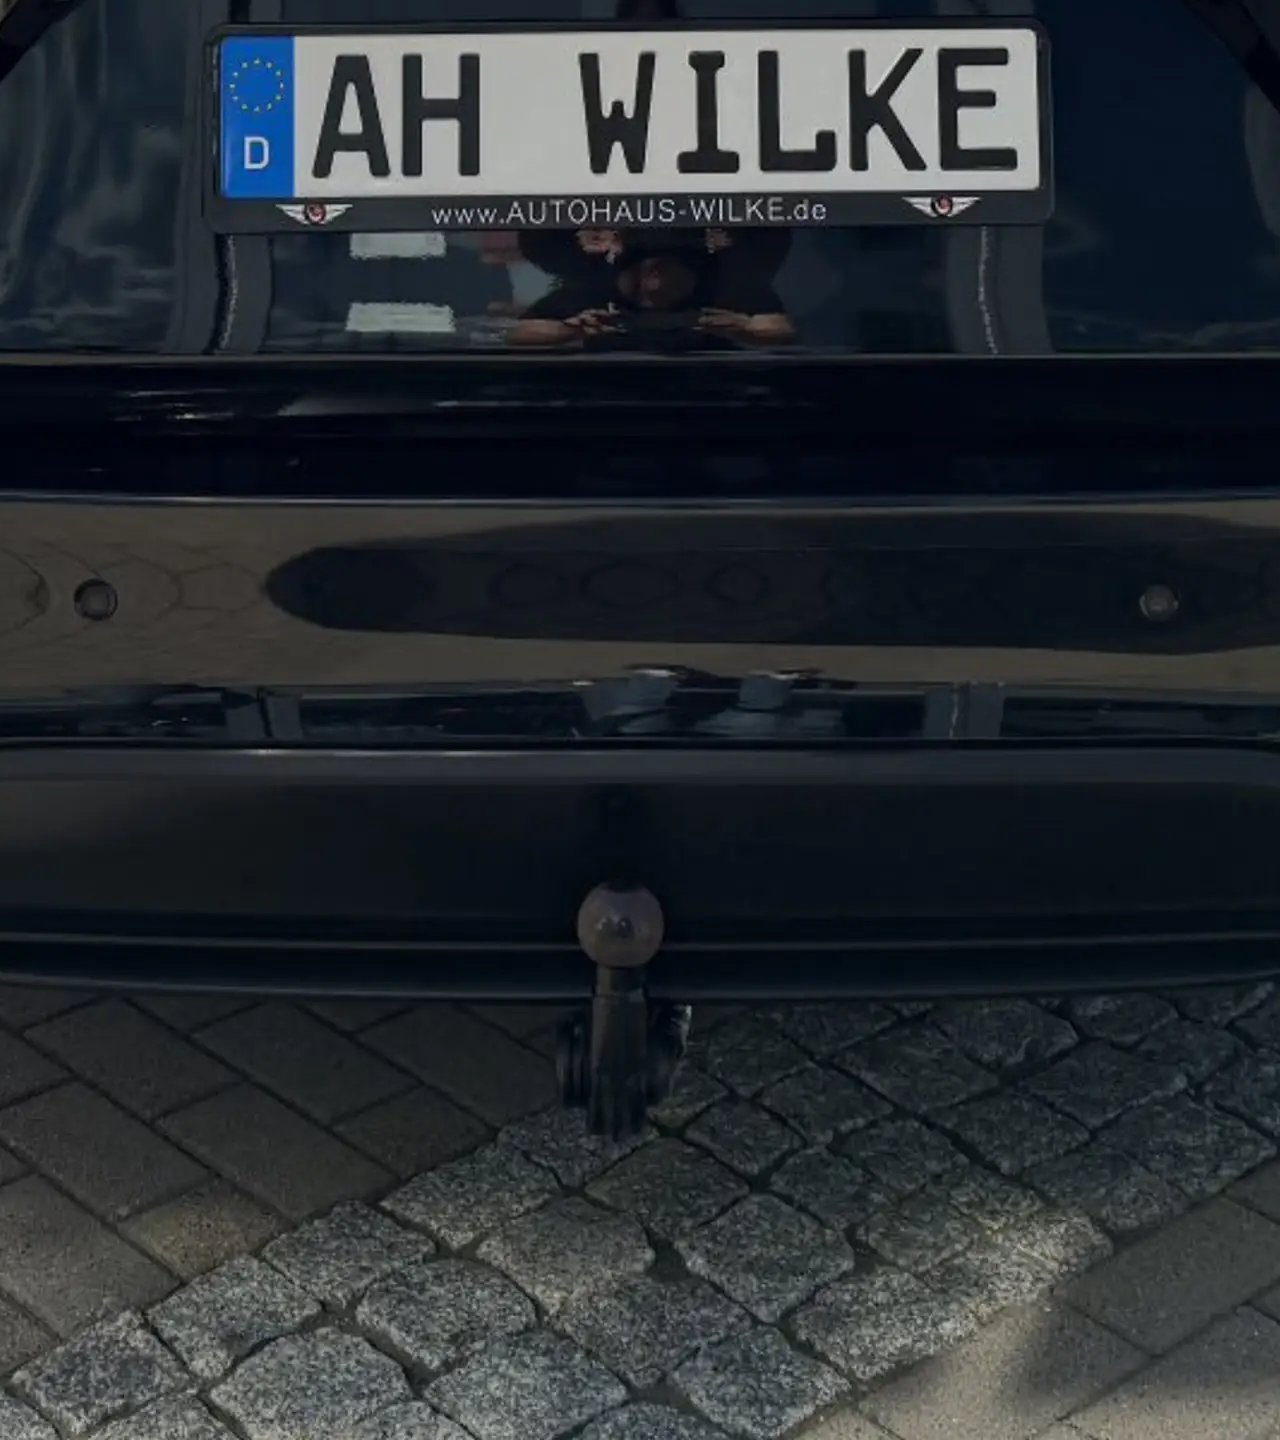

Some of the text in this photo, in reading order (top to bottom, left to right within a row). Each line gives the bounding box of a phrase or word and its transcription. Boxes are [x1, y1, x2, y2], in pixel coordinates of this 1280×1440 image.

[312, 47, 1019, 179] AH WILKE
[244, 136, 270, 170] D
[431, 197, 828, 226] www.AUTOHAUS-WILKE.de
